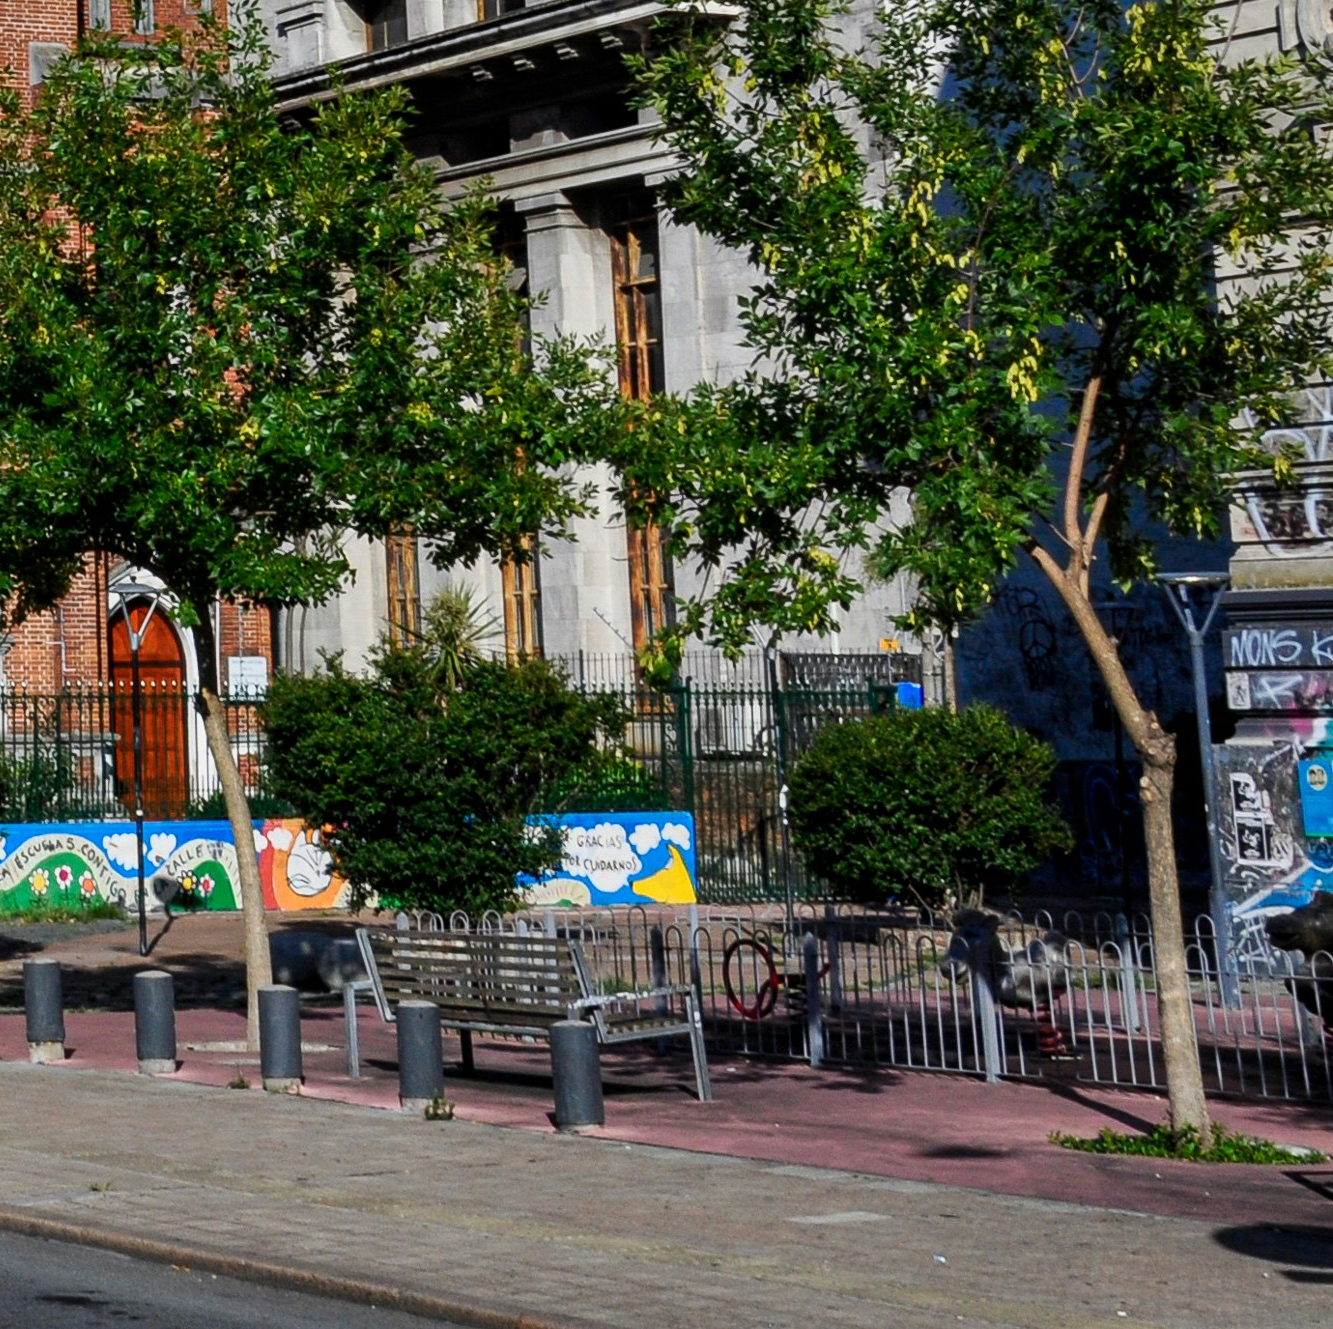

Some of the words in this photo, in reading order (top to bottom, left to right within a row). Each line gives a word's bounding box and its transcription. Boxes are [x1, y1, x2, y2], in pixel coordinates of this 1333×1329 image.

[576, 834, 623, 850] GRACIAS
[80, 843, 127, 899] CONTIGO
[167, 844, 204, 876] CALLE
[583, 858, 638, 873] CUIDARNOS
